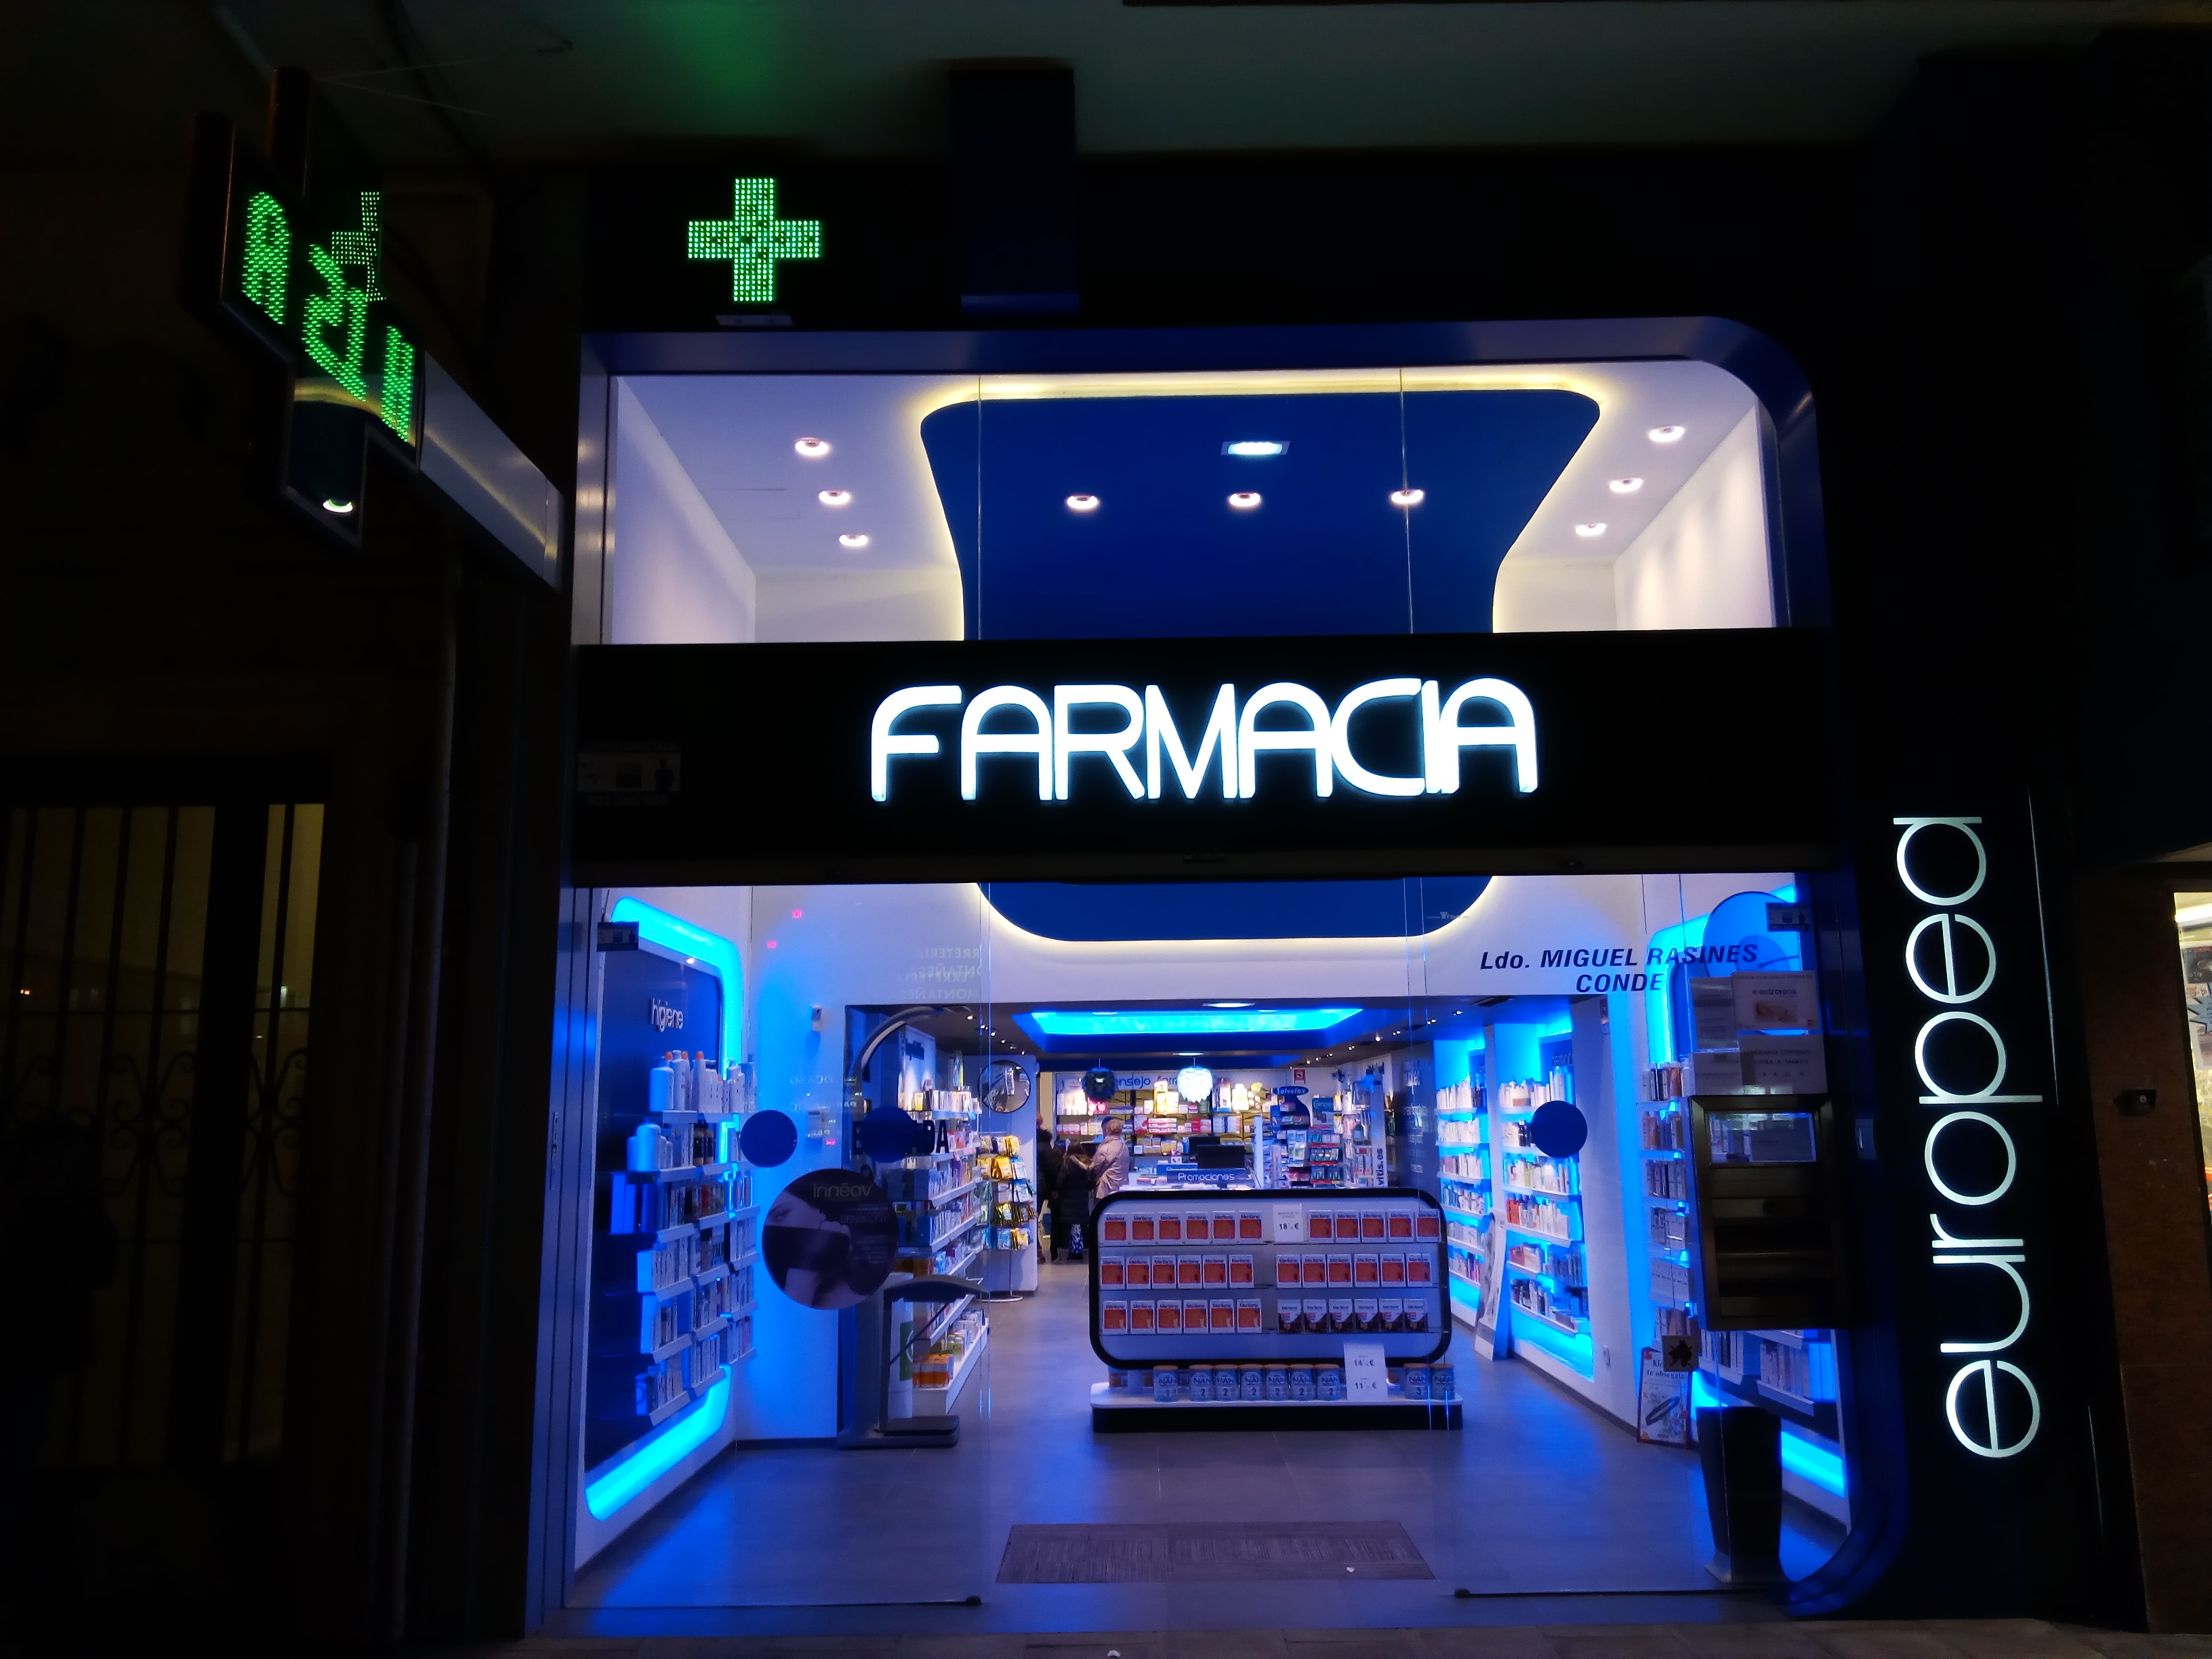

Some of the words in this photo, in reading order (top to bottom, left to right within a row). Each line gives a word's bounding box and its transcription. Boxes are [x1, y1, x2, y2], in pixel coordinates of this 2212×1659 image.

[872, 678, 1538, 801] FARMACIA
[1480, 951, 1530, 970] Ldo.
[1540, 948, 1638, 968] MIGUEL
[1647, 944, 1758, 965] RASINES
[1576, 972, 1664, 993] CONDE
[651, 998, 684, 1033] higiene
[1118, 1076, 1151, 1089] nsejo
[1893, 817, 2041, 1458] europea
[1178, 1172, 1235, 1182] Promociones
